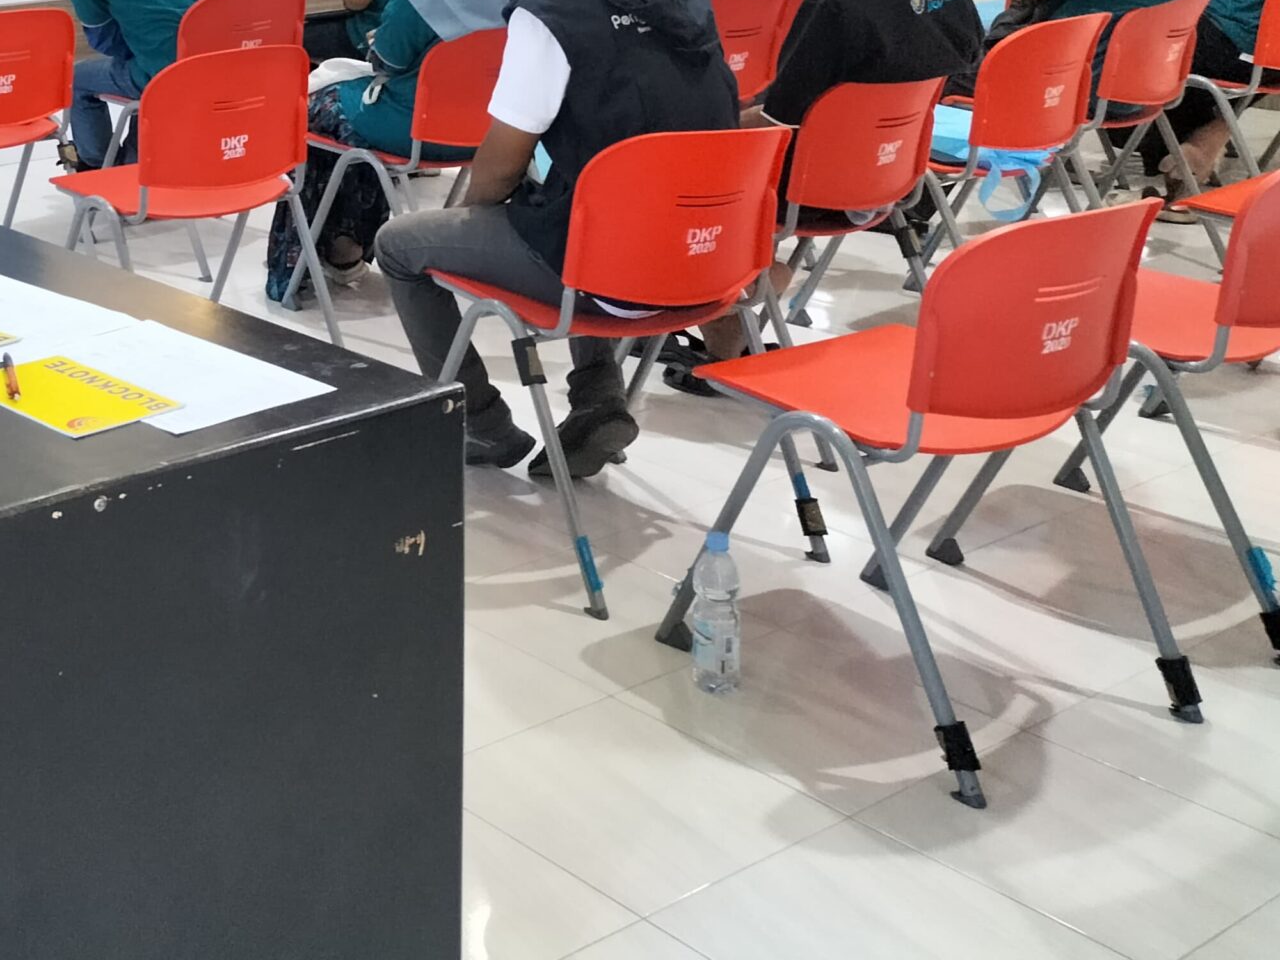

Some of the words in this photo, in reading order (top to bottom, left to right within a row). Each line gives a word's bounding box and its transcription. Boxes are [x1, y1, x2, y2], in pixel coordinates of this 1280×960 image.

[221, 134, 249, 150] DKP
[877, 139, 903, 156] DKP
[223, 147, 246, 160] 2020
[686, 225, 722, 244] DKP
[688, 240, 717, 256] 2020
[1041, 316, 1079, 341] DKP
[43, 360, 169, 411] BLOCKNOTE
